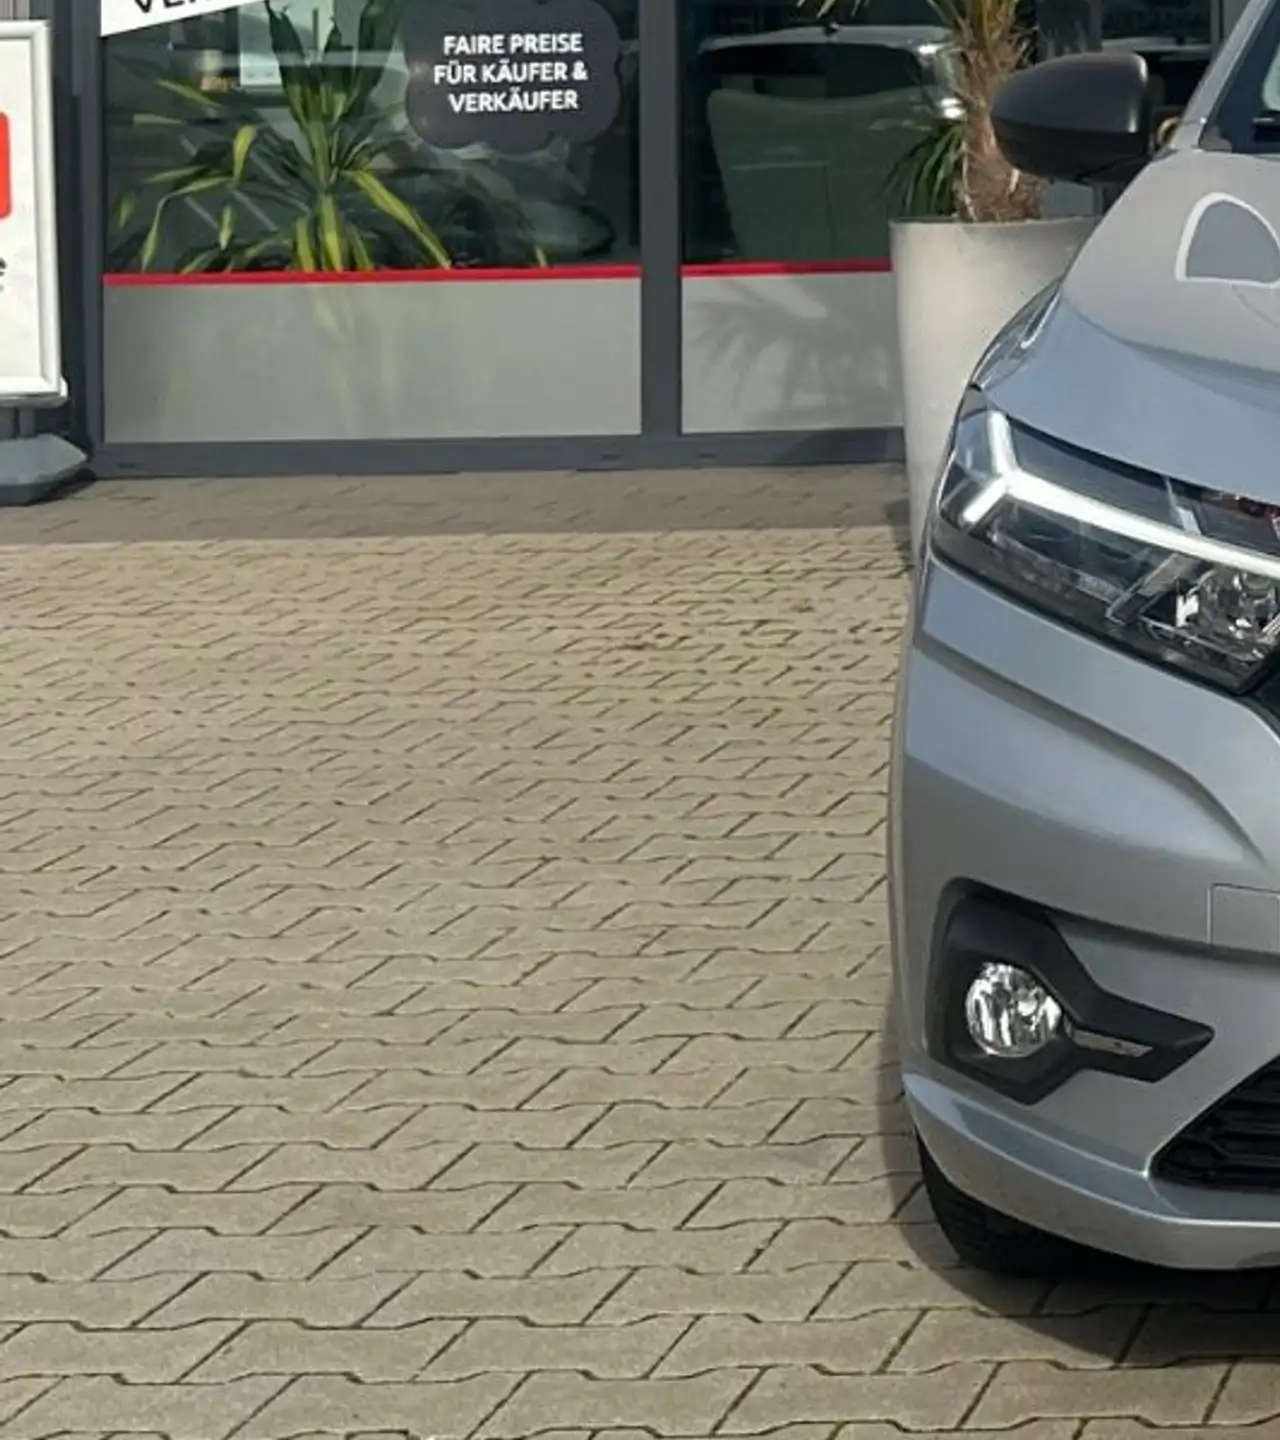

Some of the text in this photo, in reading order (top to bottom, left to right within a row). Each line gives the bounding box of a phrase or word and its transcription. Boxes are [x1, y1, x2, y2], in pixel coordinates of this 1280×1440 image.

[444, 33, 584, 55] FAIRE PREISE
[434, 58, 588, 85] FÜR KÄUFER &
[448, 86, 579, 113] VERKÄUFER
